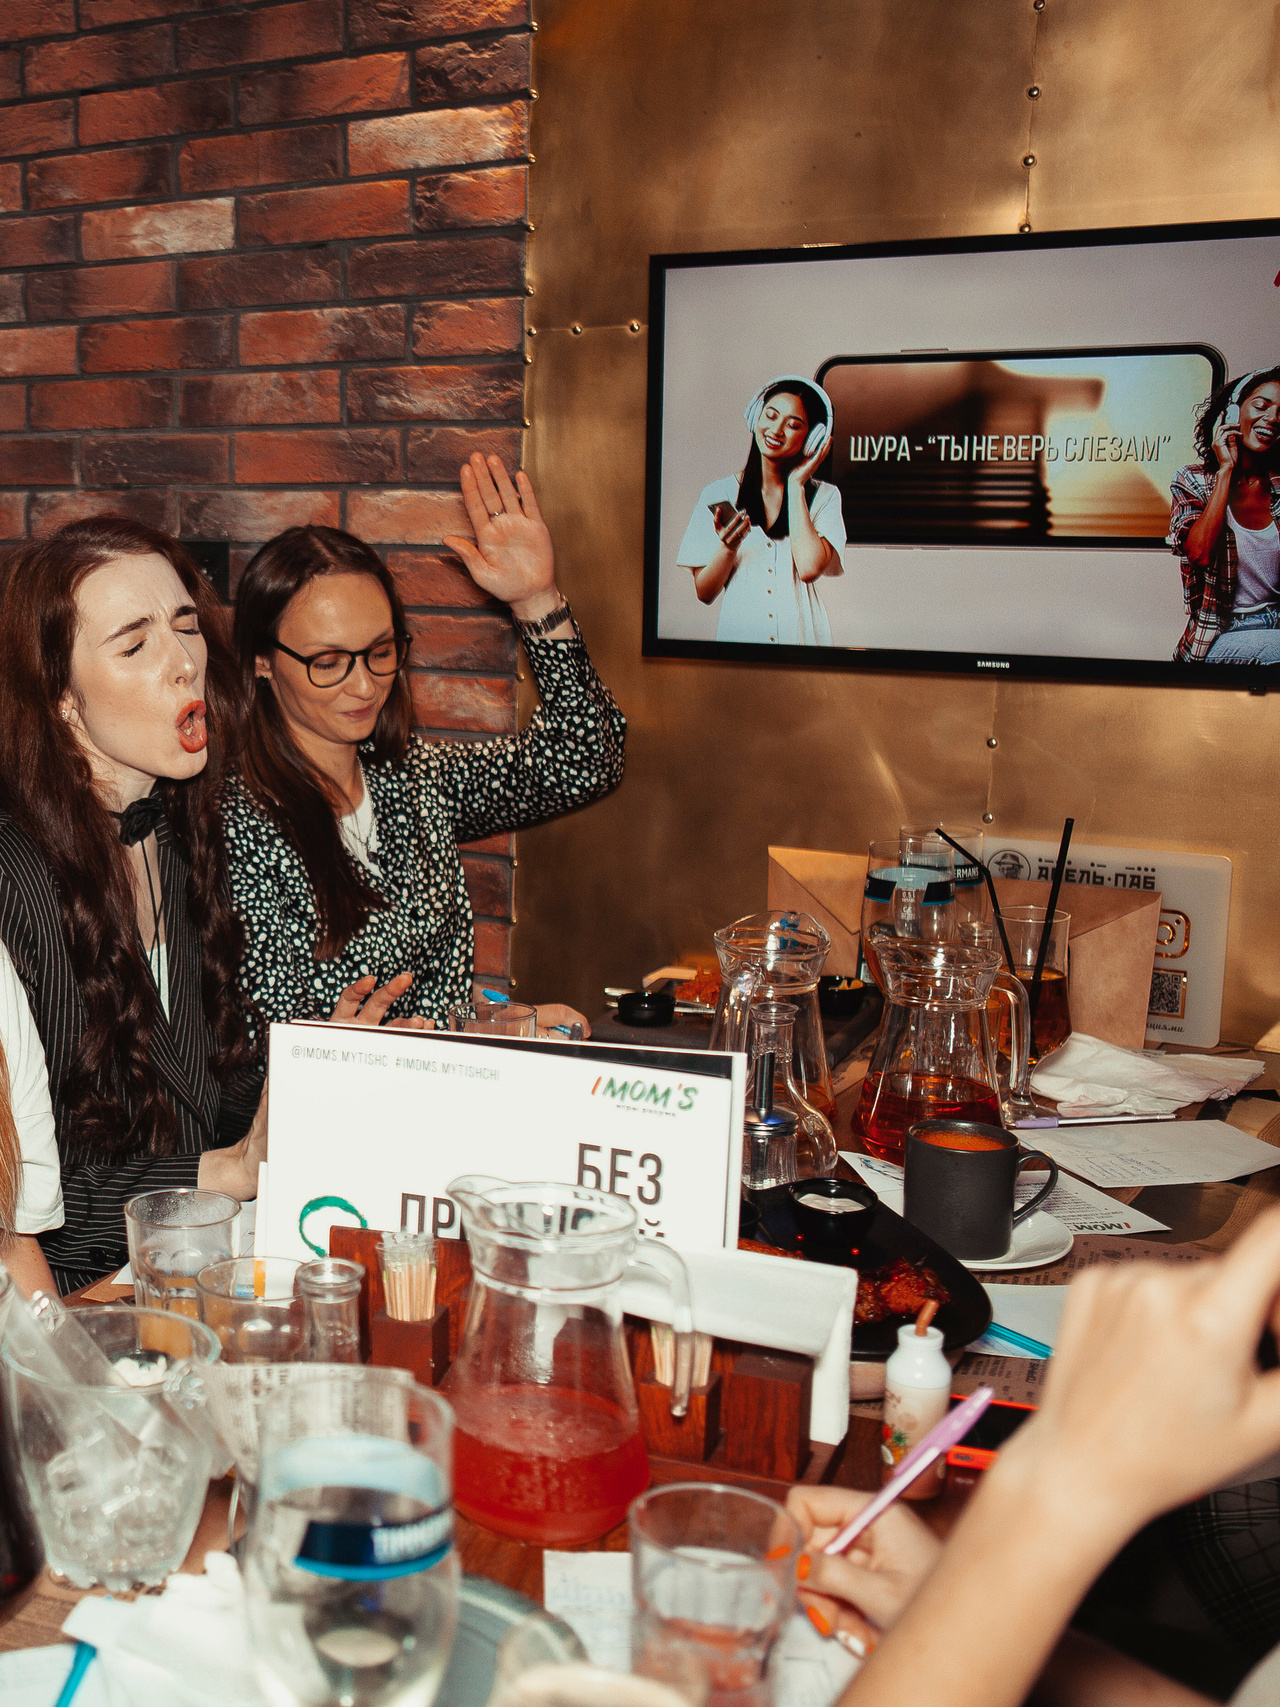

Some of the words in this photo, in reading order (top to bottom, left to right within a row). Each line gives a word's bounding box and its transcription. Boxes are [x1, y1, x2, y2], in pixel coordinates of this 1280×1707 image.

[849, 434, 911, 463] ШУРА
[970, 434, 1000, 463] НЕ
[1002, 434, 1059, 463] ВЕРЬ
[976, 659, 1011, 669] SAMSUNG
[577, 1142, 665, 1206] БЕЗ
